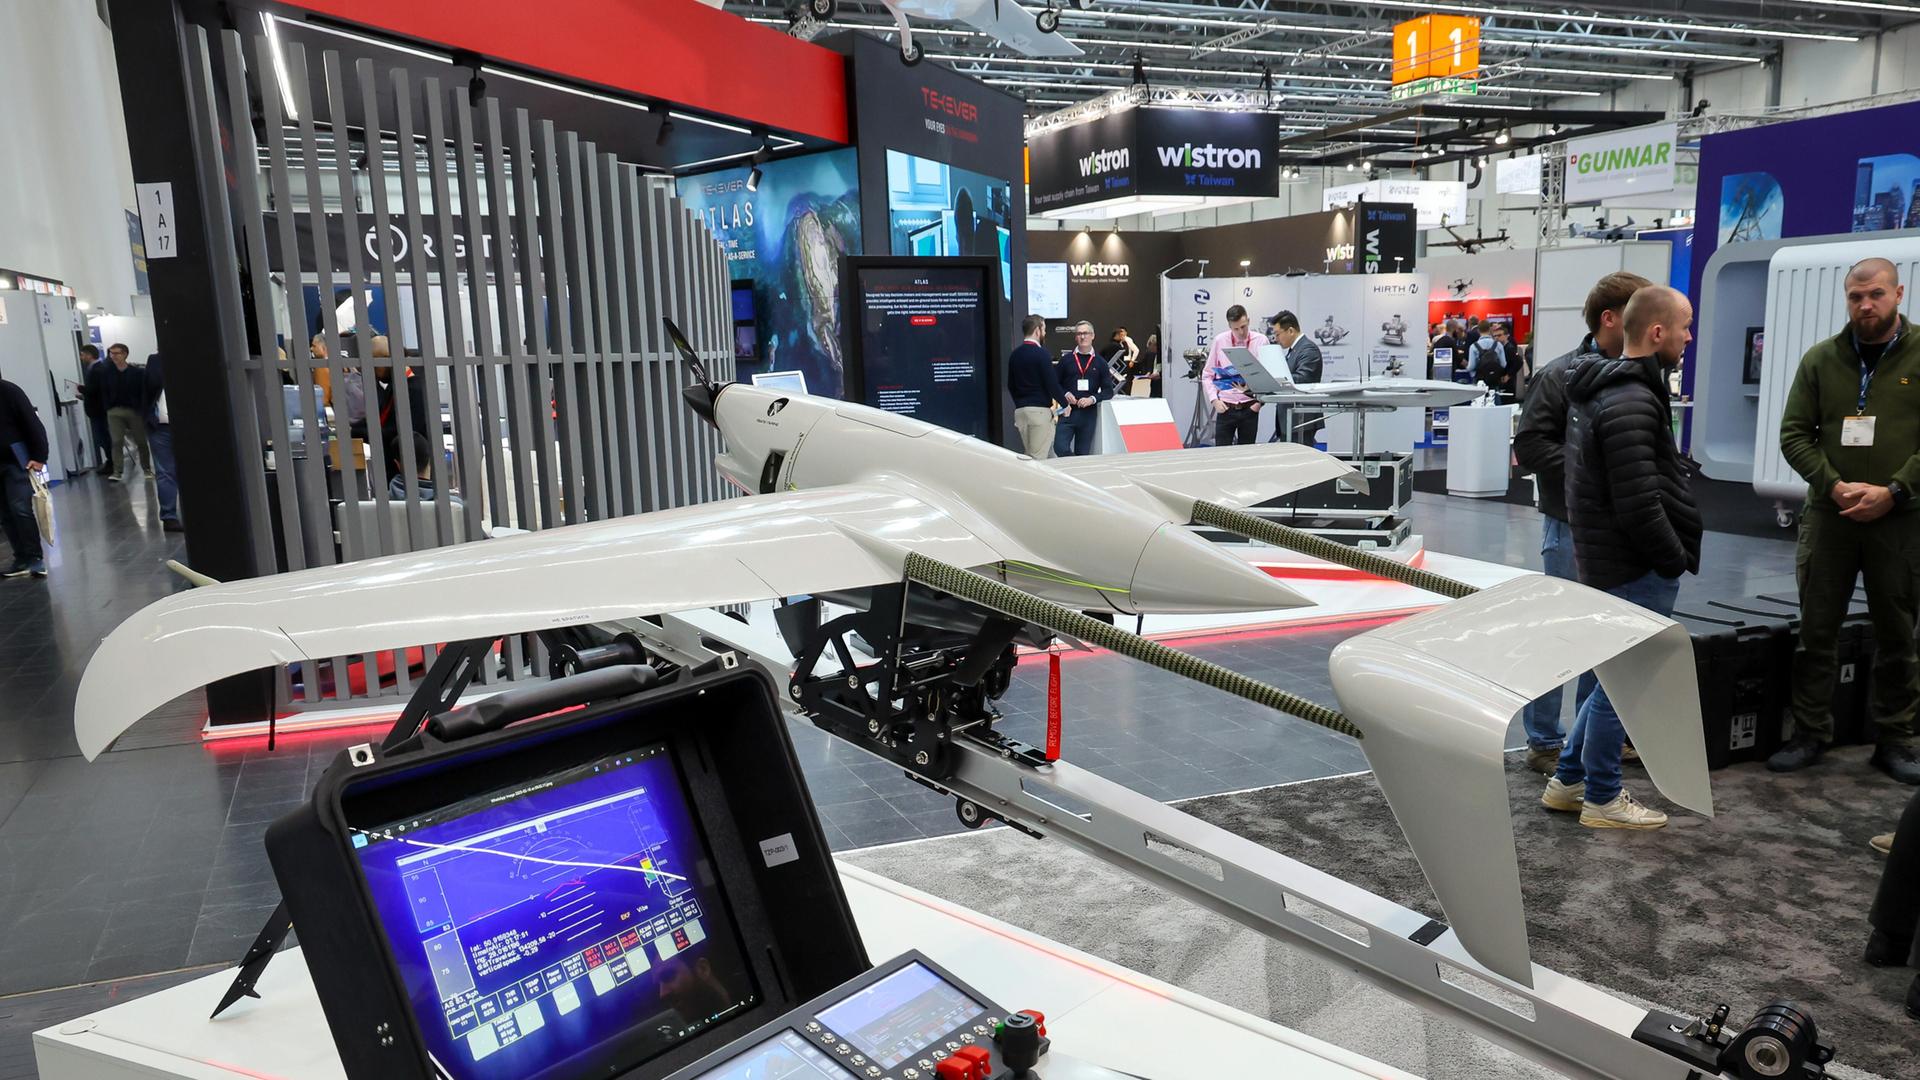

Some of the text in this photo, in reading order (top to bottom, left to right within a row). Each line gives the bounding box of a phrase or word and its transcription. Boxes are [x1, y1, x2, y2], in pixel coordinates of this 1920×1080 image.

[1407, 31, 1417, 69] 1
[1449, 27, 1462, 67] 1
[920, 86, 977, 120] TEKEVER
[1079, 147, 1129, 177] wistron
[1157, 143, 1261, 169] wistron
[1577, 142, 1671, 174] GUNNAR
[1199, 174, 1235, 187] Taiwan
[155, 190, 161, 205] 1
[158, 213, 167, 229] A
[1378, 210, 1406, 221] Taiwan
[158, 235, 170, 250] 17
[1326, 243, 1355, 261] wistr
[1366, 228, 1382, 274] wis
[1070, 262, 1130, 276] wistron
[1373, 285, 1406, 293] HIRTH
[1197, 311, 1208, 346] RTH
[1050, 696, 1058, 719] BEFORE
[1048, 720, 1057, 747] REMOVE
